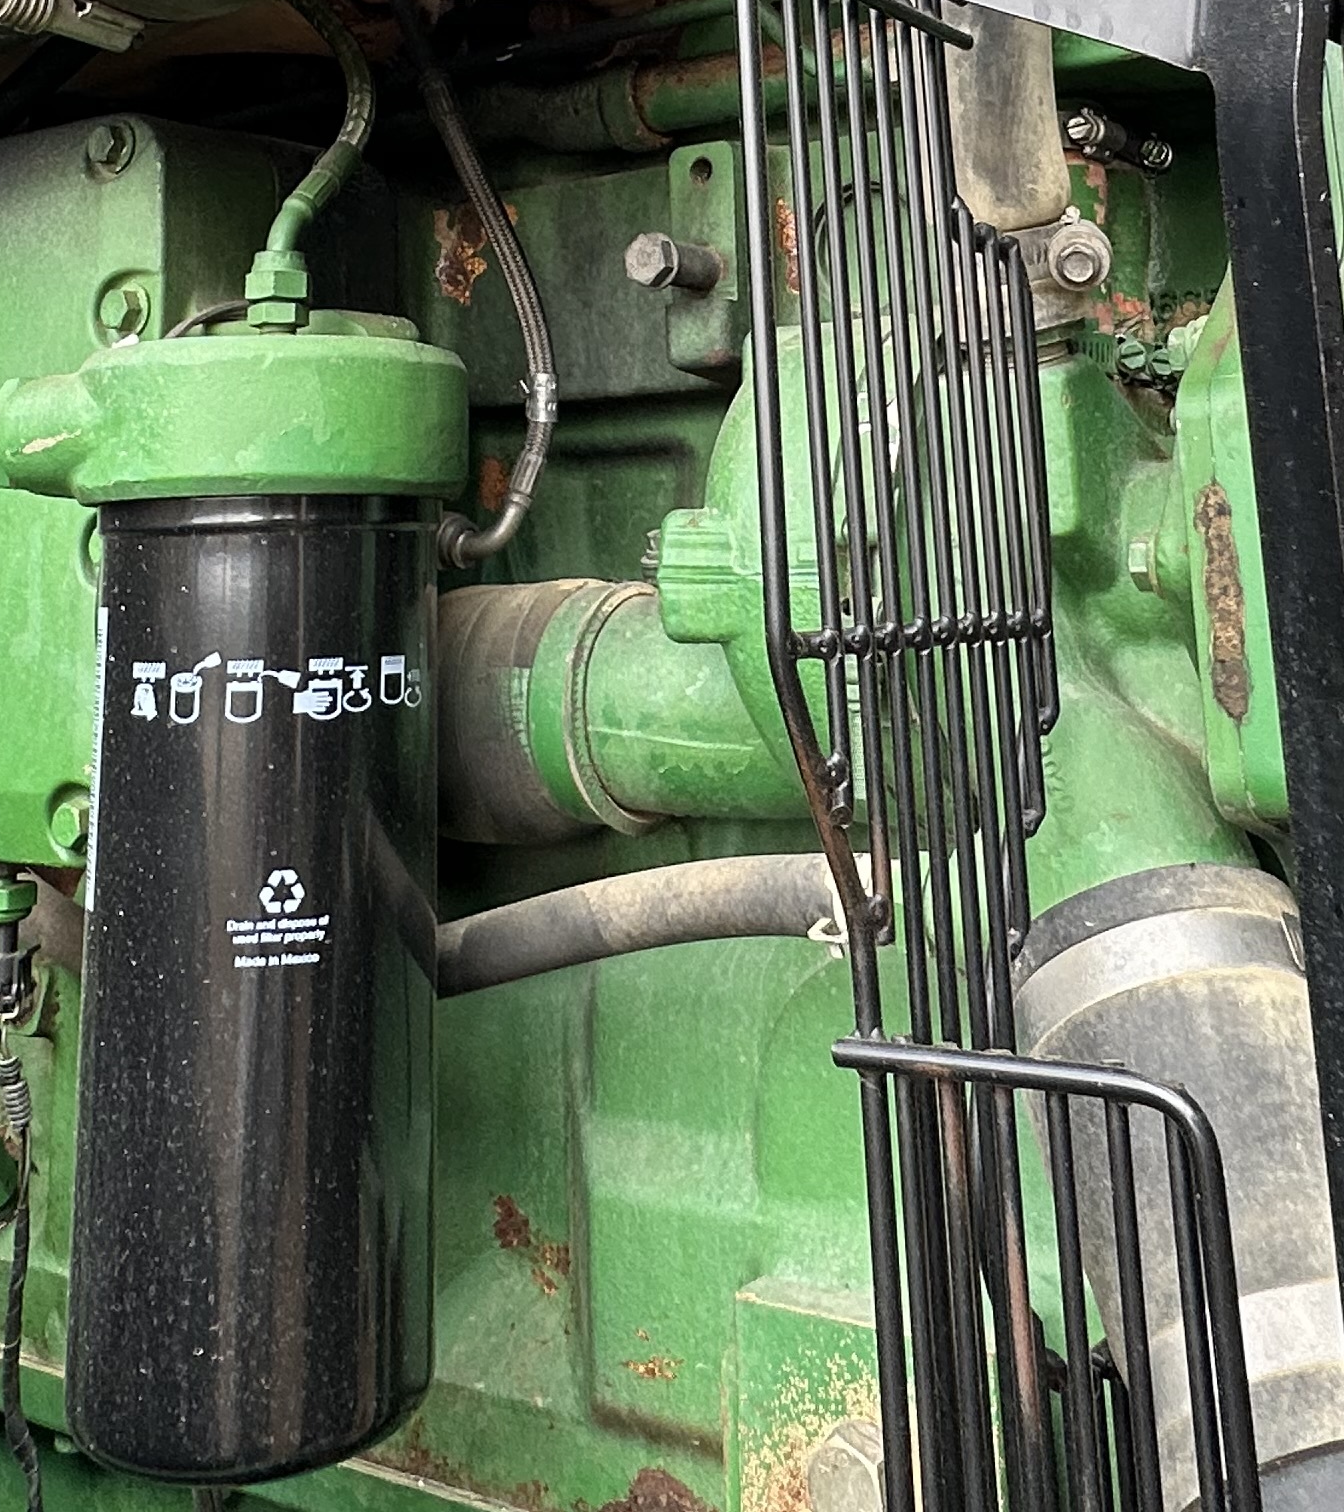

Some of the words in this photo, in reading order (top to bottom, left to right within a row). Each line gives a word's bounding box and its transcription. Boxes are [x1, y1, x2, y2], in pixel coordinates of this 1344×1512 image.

[226, 919, 255, 932] Drain
[255, 918, 276, 930] and
[277, 918, 318, 930] dispose
[318, 914, 330, 926] of
[232, 933, 259, 944] used
[260, 931, 284, 943] filter
[283, 929, 326, 945] properly
[234, 955, 267, 968] Made
[268, 955, 280, 966] in
[281, 953, 320, 966] Mexico
